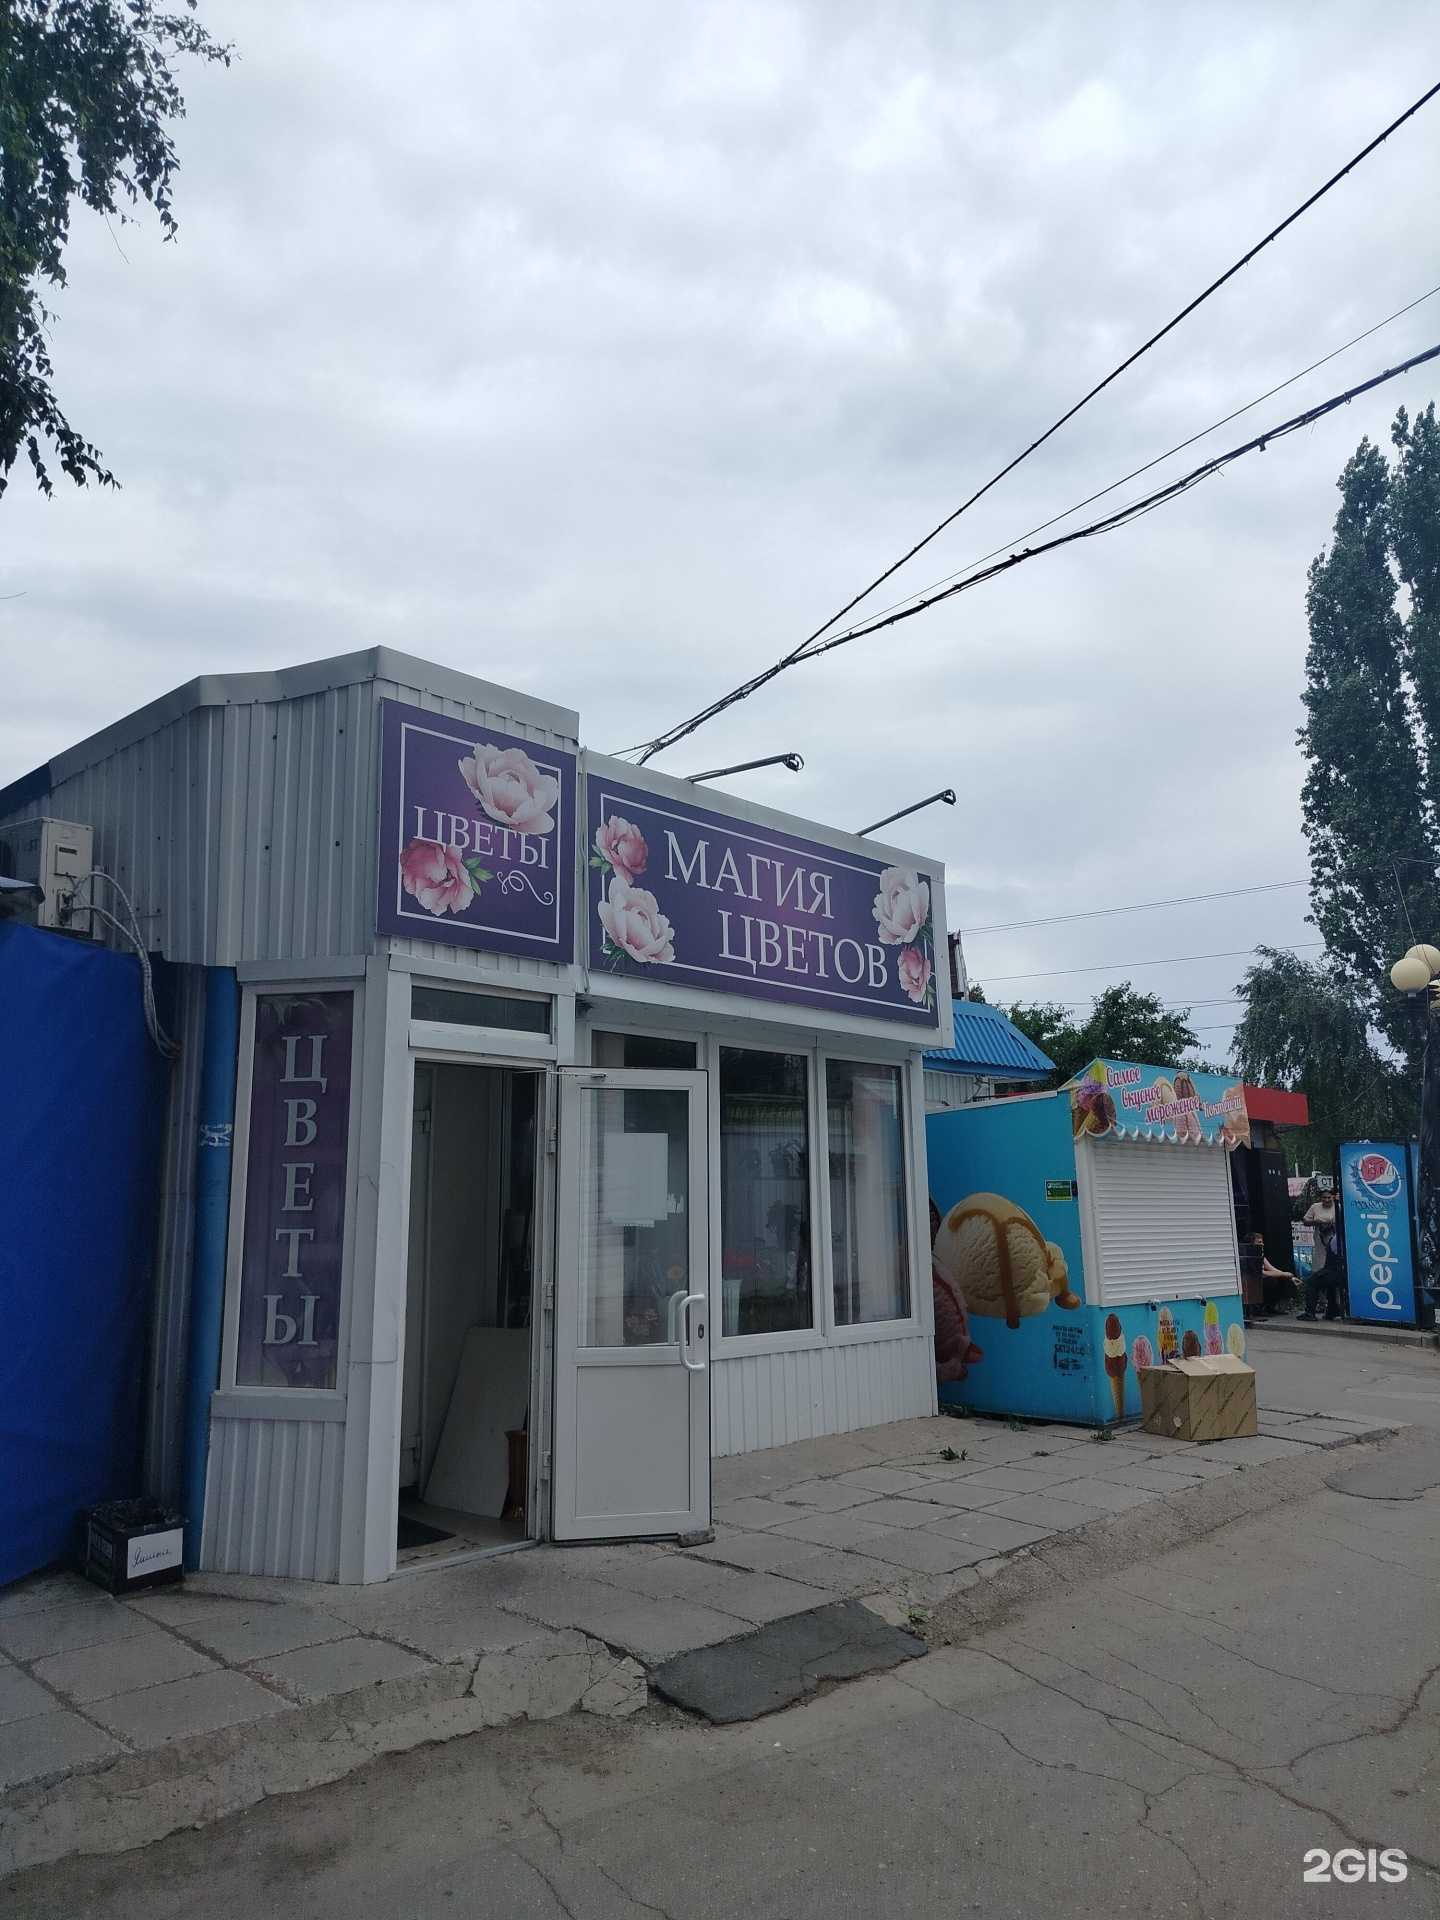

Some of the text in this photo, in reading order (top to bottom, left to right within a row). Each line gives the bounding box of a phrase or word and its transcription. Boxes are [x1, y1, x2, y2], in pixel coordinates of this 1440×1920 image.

[413, 805, 550, 869] ЦВЕТЫ
[664, 830, 834, 919] МАГИЯ
[717, 909, 888, 988] ЦВЕТОВ
[1106, 1065, 1141, 1088] Самое
[1145, 1097, 1200, 1124] мороженое
[263, 1034, 328, 1347] ЦВЕТЫ
[1361, 1213, 1402, 1310] pepsi
